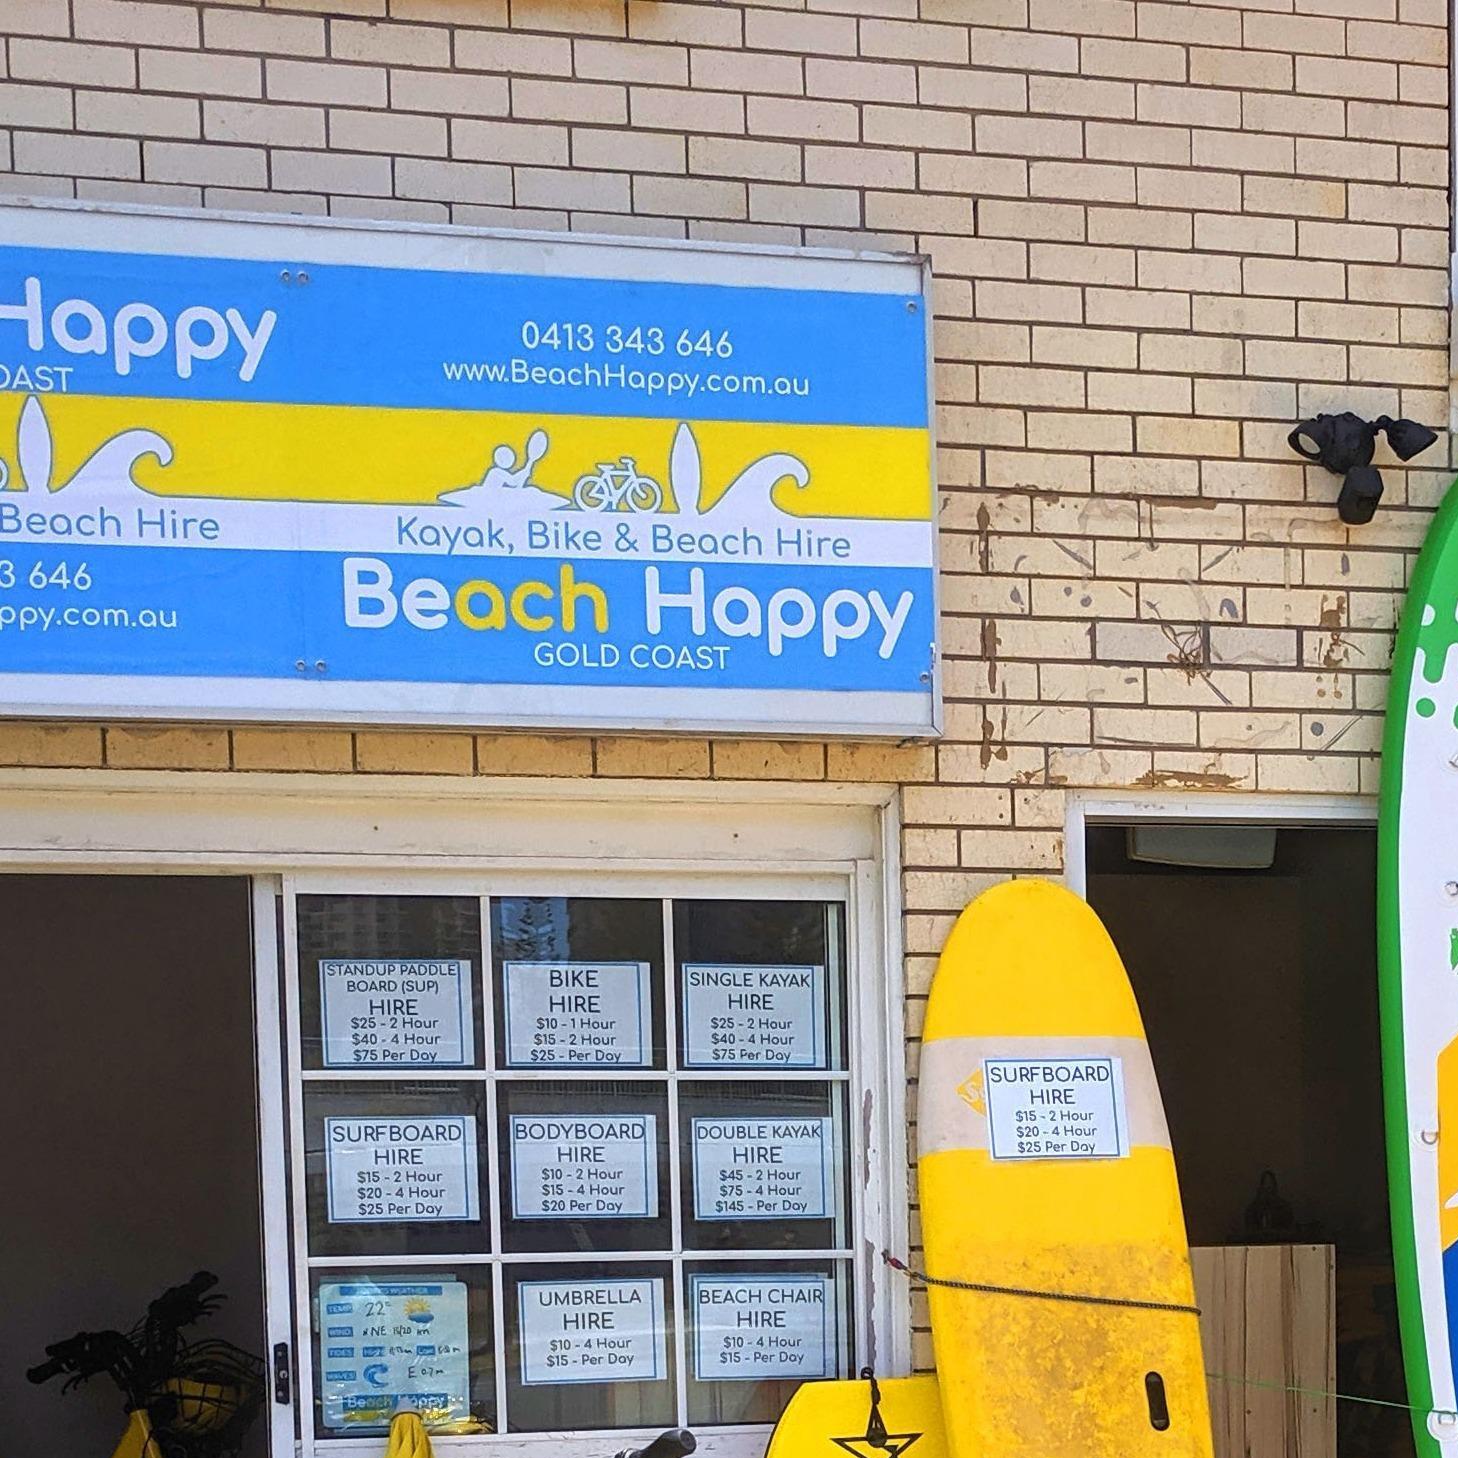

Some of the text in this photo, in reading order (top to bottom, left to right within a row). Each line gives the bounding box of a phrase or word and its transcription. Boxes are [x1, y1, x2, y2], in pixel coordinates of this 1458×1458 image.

[522, 321, 732, 358] 0413 343 646
[443, 359, 809, 397] www.BeachHappy.com.au
[0, 503, 220, 540] Beach Hire
[397, 516, 851, 558] Kayak, Bike & Beach Hire
[29, 561, 92, 590] 646
[343, 557, 914, 659] Beach Happy
[534, 643, 730, 670] GOLD COAST
[327, 964, 456, 976] STANDUP PADDLE
[550, 970, 598, 987] BIKE
[690, 972, 810, 988] SINGLE KAYAK
[347, 981, 438, 994] BOARD (SUP)
[370, 999, 418, 1015] HIRE
[550, 996, 600, 1013] HIRE
[729, 994, 774, 1010] HIRE
[351, 1017, 439, 1029] $25 2 Hour
[536, 1017, 616, 1029] $10 1 Hour
[711, 1017, 792, 1029] $25 2 Hour
[352, 1033, 441, 1046] $40 4 Hour
[534, 1034, 616, 1045] $15 2 Hour
[711, 1033, 794, 1045] $40 4 Hour
[354, 1050, 437, 1063] $75 Per Day
[531, 1050, 621, 1064] $25 Per Day
[713, 1049, 791, 1063] $75 Per Day
[991, 1066, 1109, 1083] SURFBOARD
[1031, 1089, 1075, 1105] HIRE
[1016, 1110, 1094, 1122] $15 2 Hour
[333, 1125, 461, 1142] SURFBOARD
[516, 1124, 645, 1139] BODYBOARD
[698, 1126, 821, 1139] DOUBLE KAYAK
[1017, 1126, 1097, 1138] $20 4 Hour
[558, 1147, 605, 1163] HIRE
[733, 1147, 782, 1163] HIRE
[1018, 1141, 1095, 1155] $25 Per Day
[375, 1149, 423, 1165] HIRE
[358, 1171, 443, 1183] $15 2 Hour
[542, 1168, 623, 1180] $10 2 Hour
[720, 1170, 801, 1181] $45 2 Hour
[358, 1187, 446, 1200] $20 4 Hour
[542, 1184, 625, 1196] $15 4 Hour
[720, 1185, 802, 1197] $75 4 Hour
[359, 1203, 442, 1216] $25 Per Day
[542, 1200, 622, 1214] $20 Per Day
[716, 1200, 807, 1213] $145 Per Day
[539, 1289, 641, 1306] UMBRELLA
[700, 1289, 823, 1303] BEACH CHAIR
[564, 1312, 614, 1330] HIRE
[738, 1311, 786, 1328] HIRE
[550, 1338, 632, 1351] $10 4 Hour
[724, 1336, 802, 1348] $10 4 Hour
[547, 1353, 634, 1367] $15 Per Day
[720, 1352, 804, 1364] $15 Per Day
